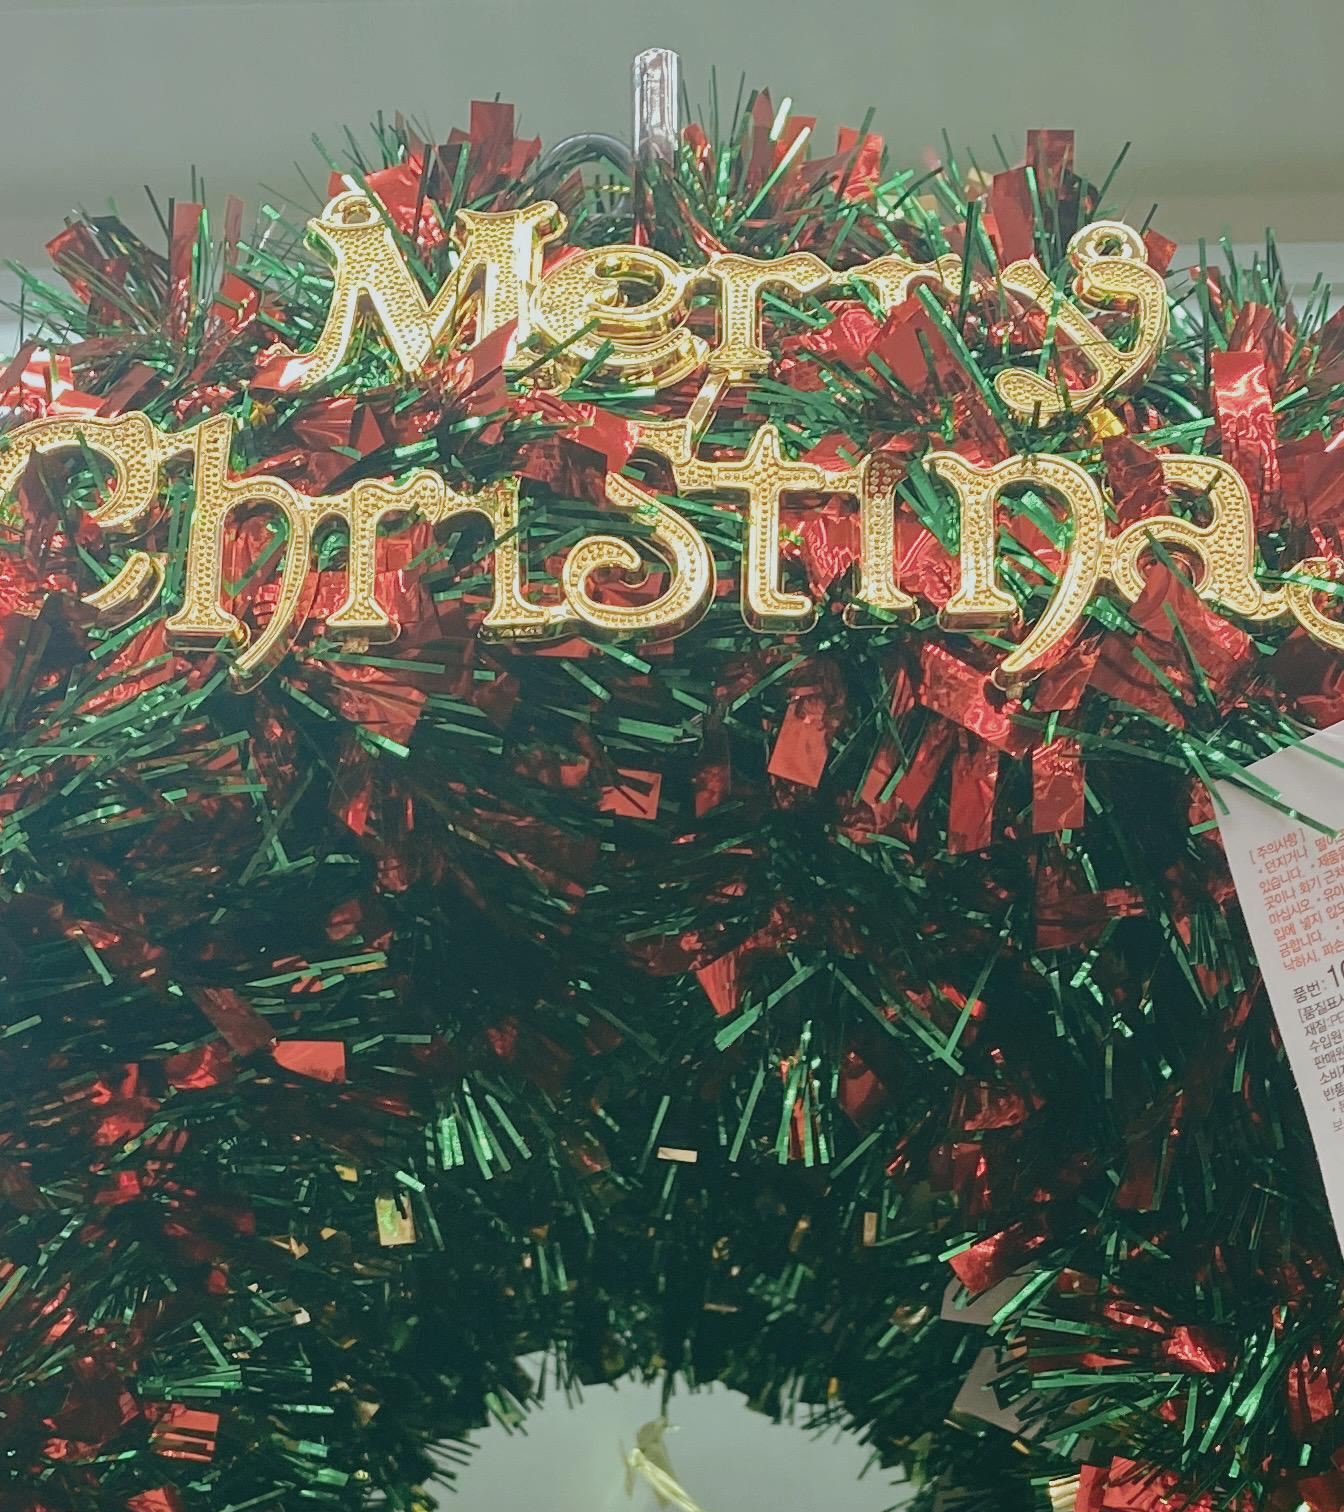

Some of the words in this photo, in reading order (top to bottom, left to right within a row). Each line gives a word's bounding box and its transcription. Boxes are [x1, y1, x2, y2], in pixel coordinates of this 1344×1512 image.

[1264, 844, 1308, 874] 던지거나
[1263, 885, 1296, 911] 곳이나
[1298, 874, 1321, 894] 화기
[1273, 922, 1296, 942] 입에
[1293, 979, 1326, 1003] 품번:
[1323, 1081, 1344, 1101] 반품
